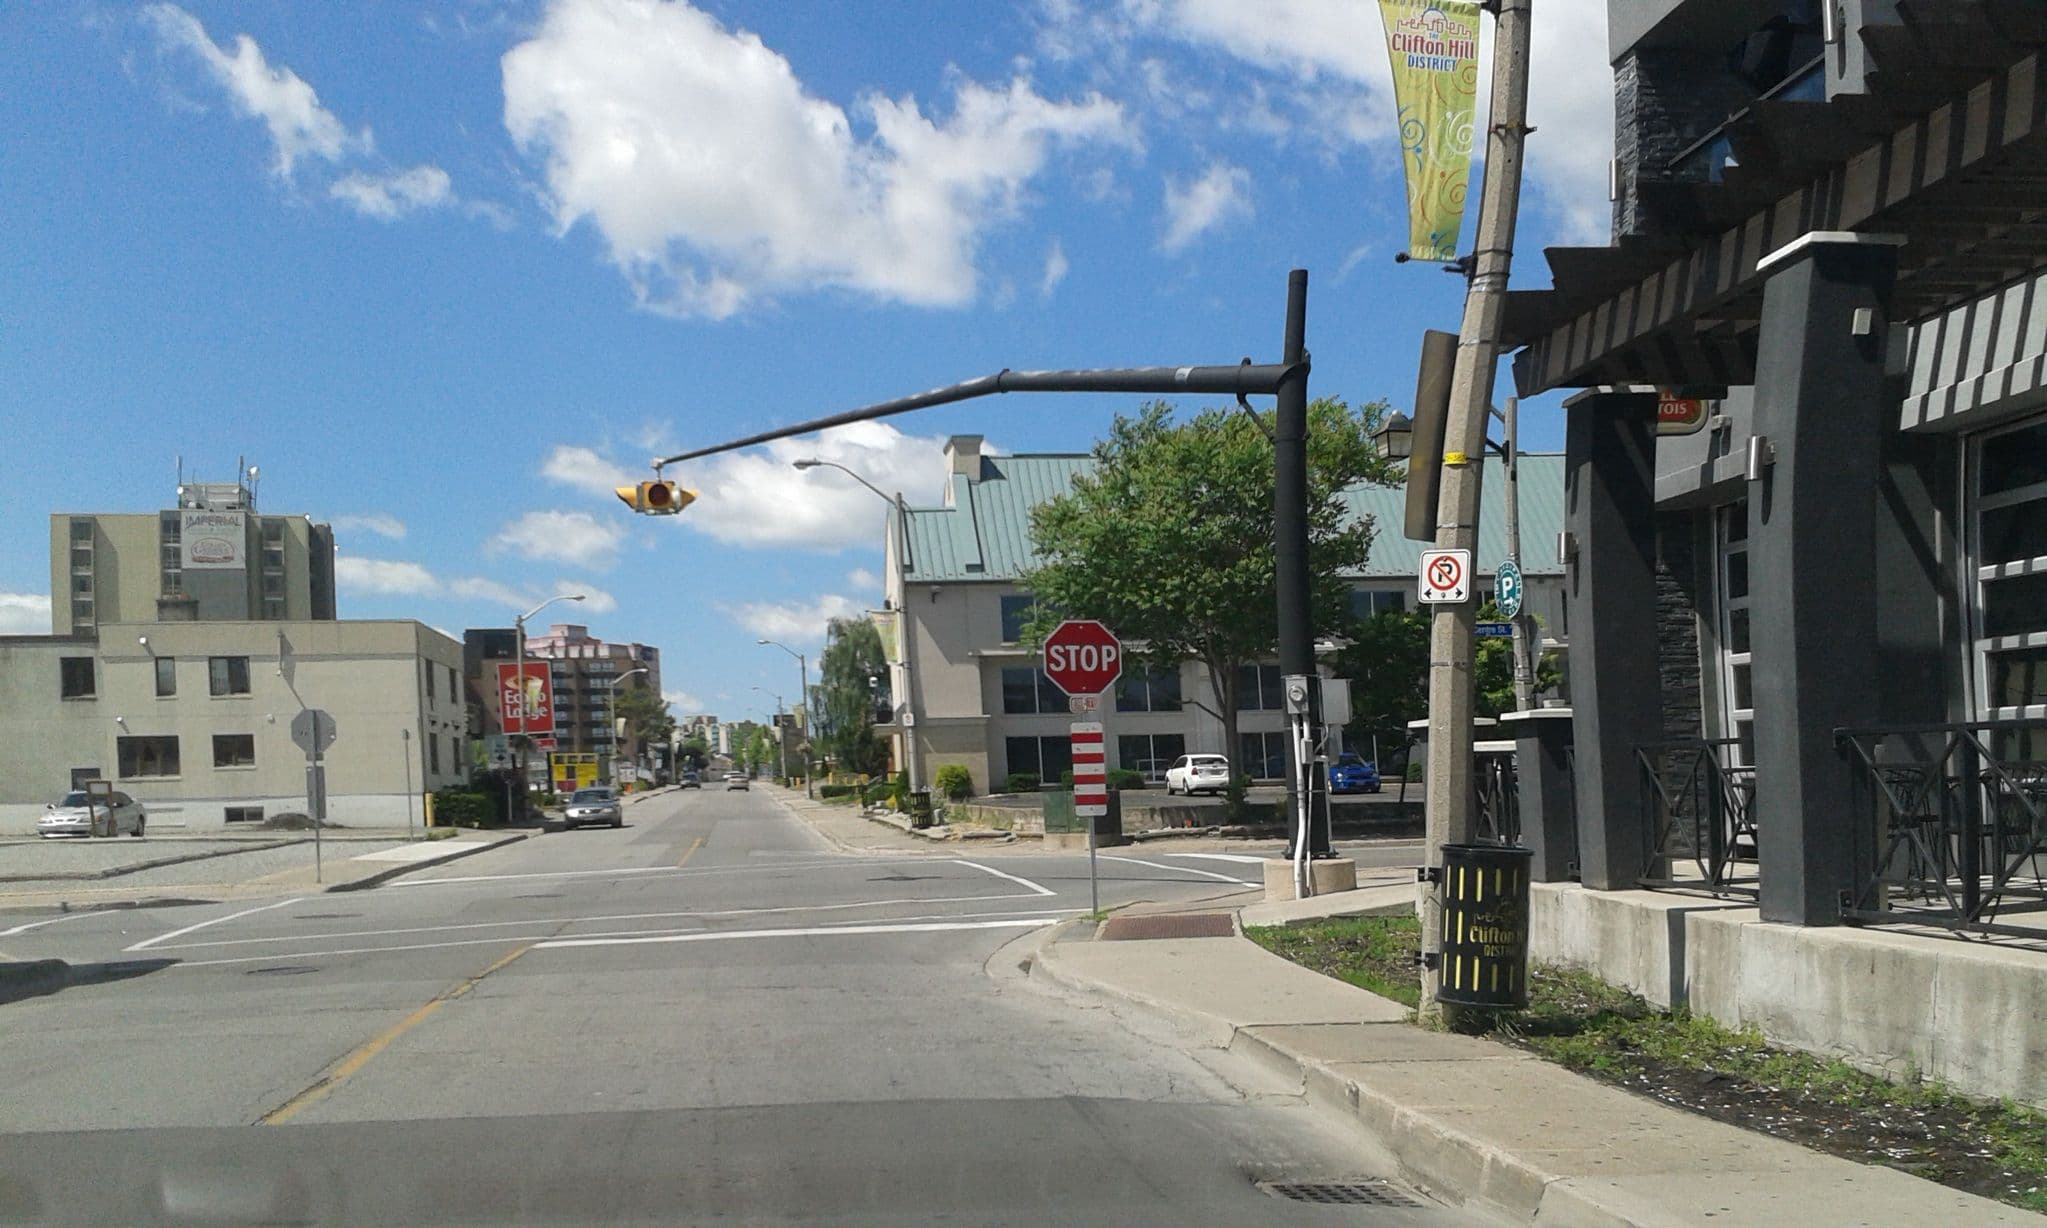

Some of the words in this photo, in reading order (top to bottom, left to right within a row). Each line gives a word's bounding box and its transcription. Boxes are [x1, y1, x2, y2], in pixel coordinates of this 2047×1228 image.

[1391, 33, 1444, 56] Clifton
[1448, 40, 1474, 59] Hill
[1407, 55, 1457, 72] DISTRICT
[1049, 645, 1117, 672] STOP
